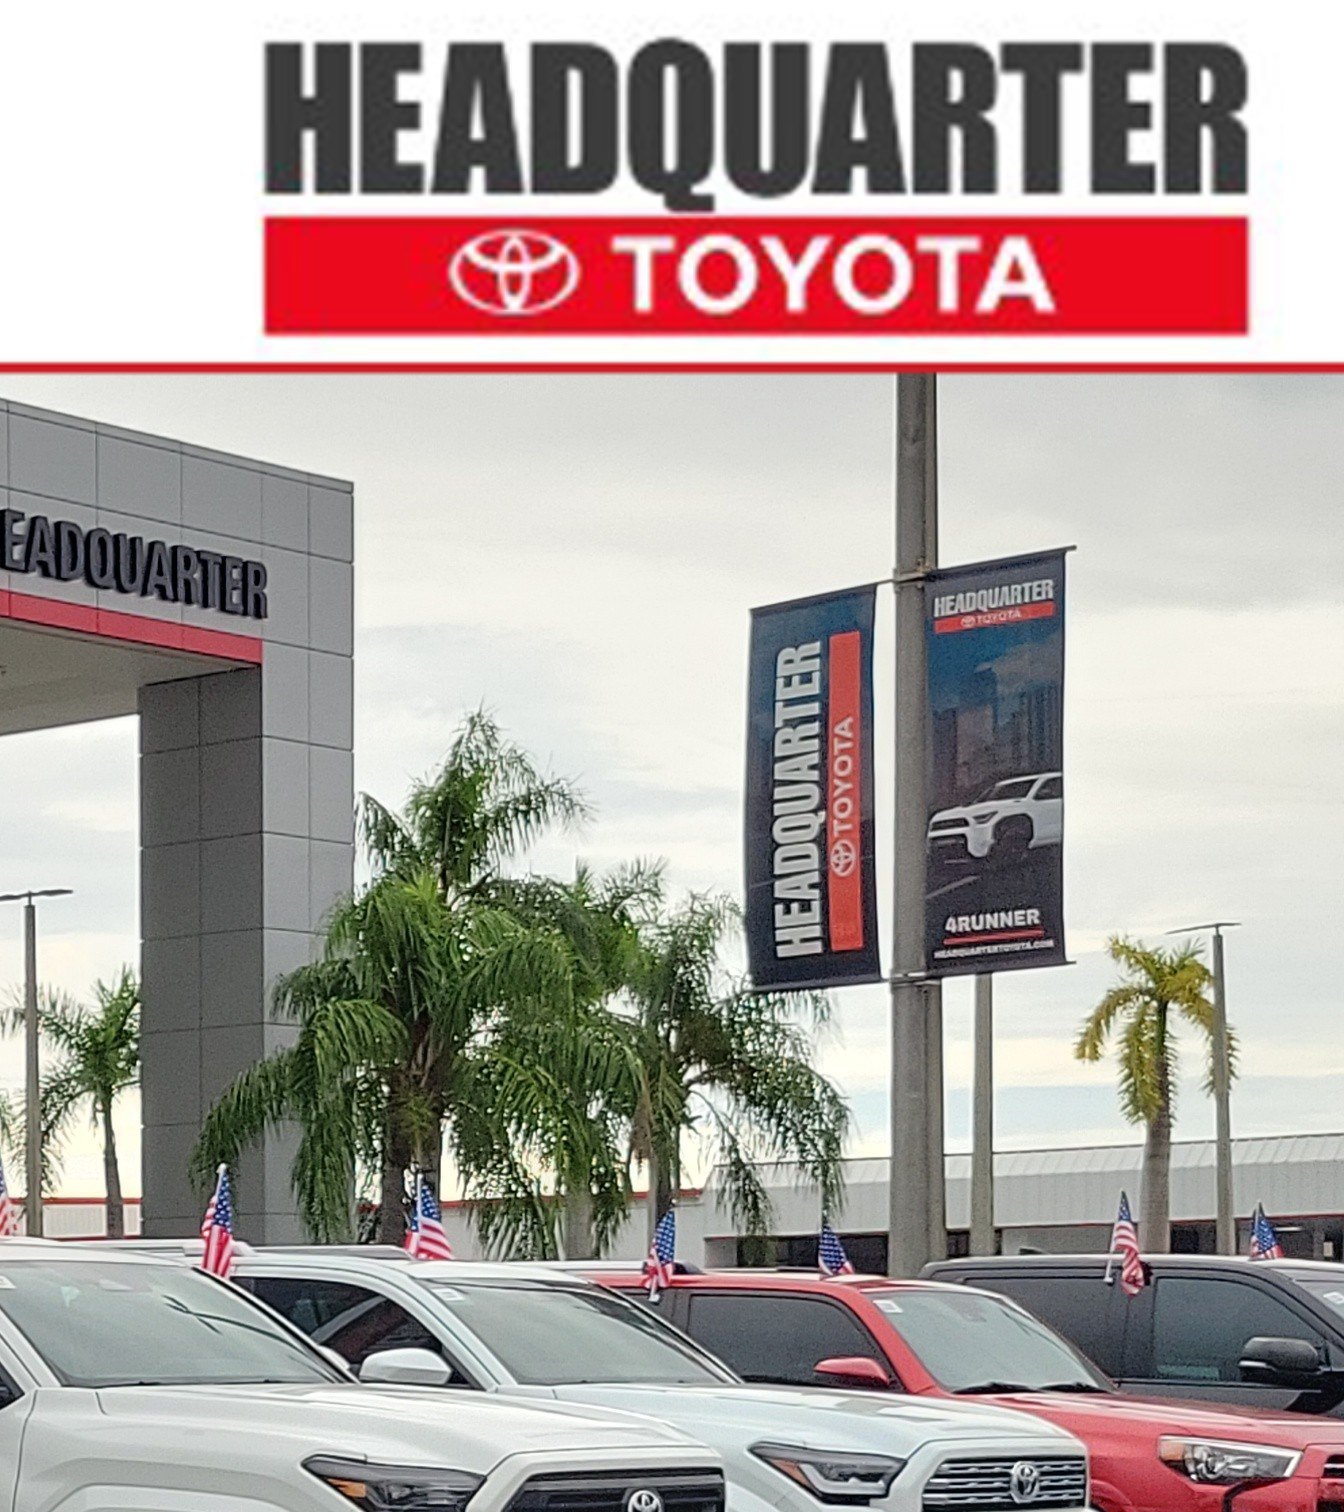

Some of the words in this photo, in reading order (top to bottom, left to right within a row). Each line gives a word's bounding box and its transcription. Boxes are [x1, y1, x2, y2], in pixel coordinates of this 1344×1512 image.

[933, 578, 1055, 619] HEADQUARTER
[976, 608, 1023, 625] TOYOTA
[831, 715, 855, 838] TOYOTA
[772, 640, 826, 959] HEADQUARTER
[944, 907, 1041, 934] 4RUNNER
